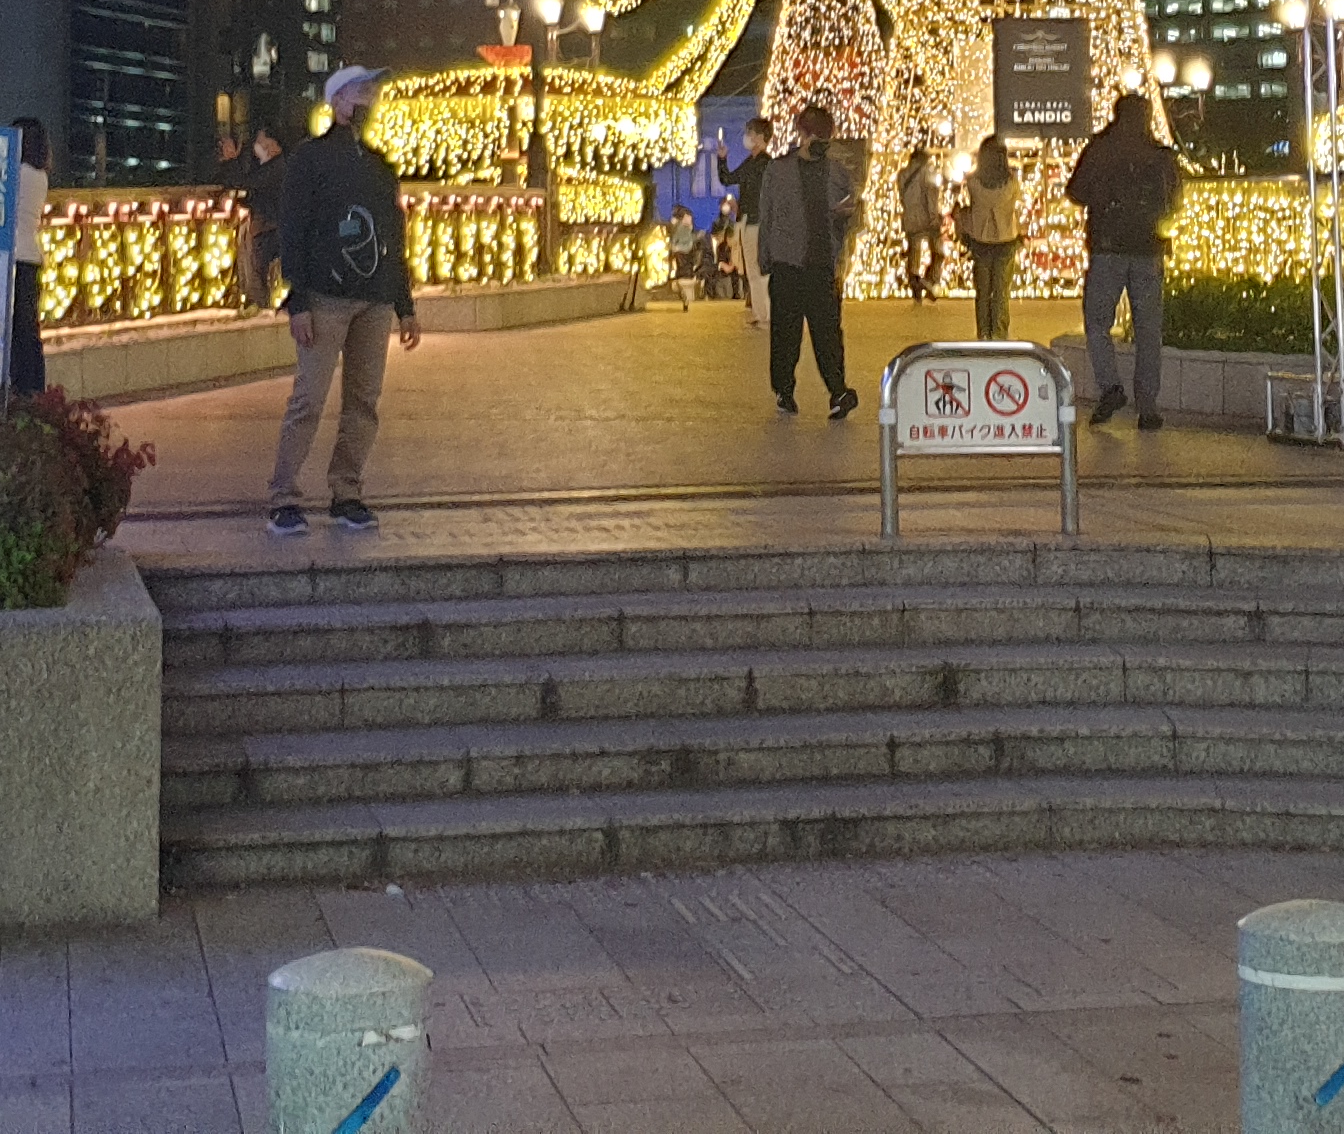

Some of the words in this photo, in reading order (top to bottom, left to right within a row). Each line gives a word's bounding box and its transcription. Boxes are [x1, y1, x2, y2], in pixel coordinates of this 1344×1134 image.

[1013, 110, 1072, 123] LANDIC
[909, 423, 1048, 441] 自転車バイク進入禁止
